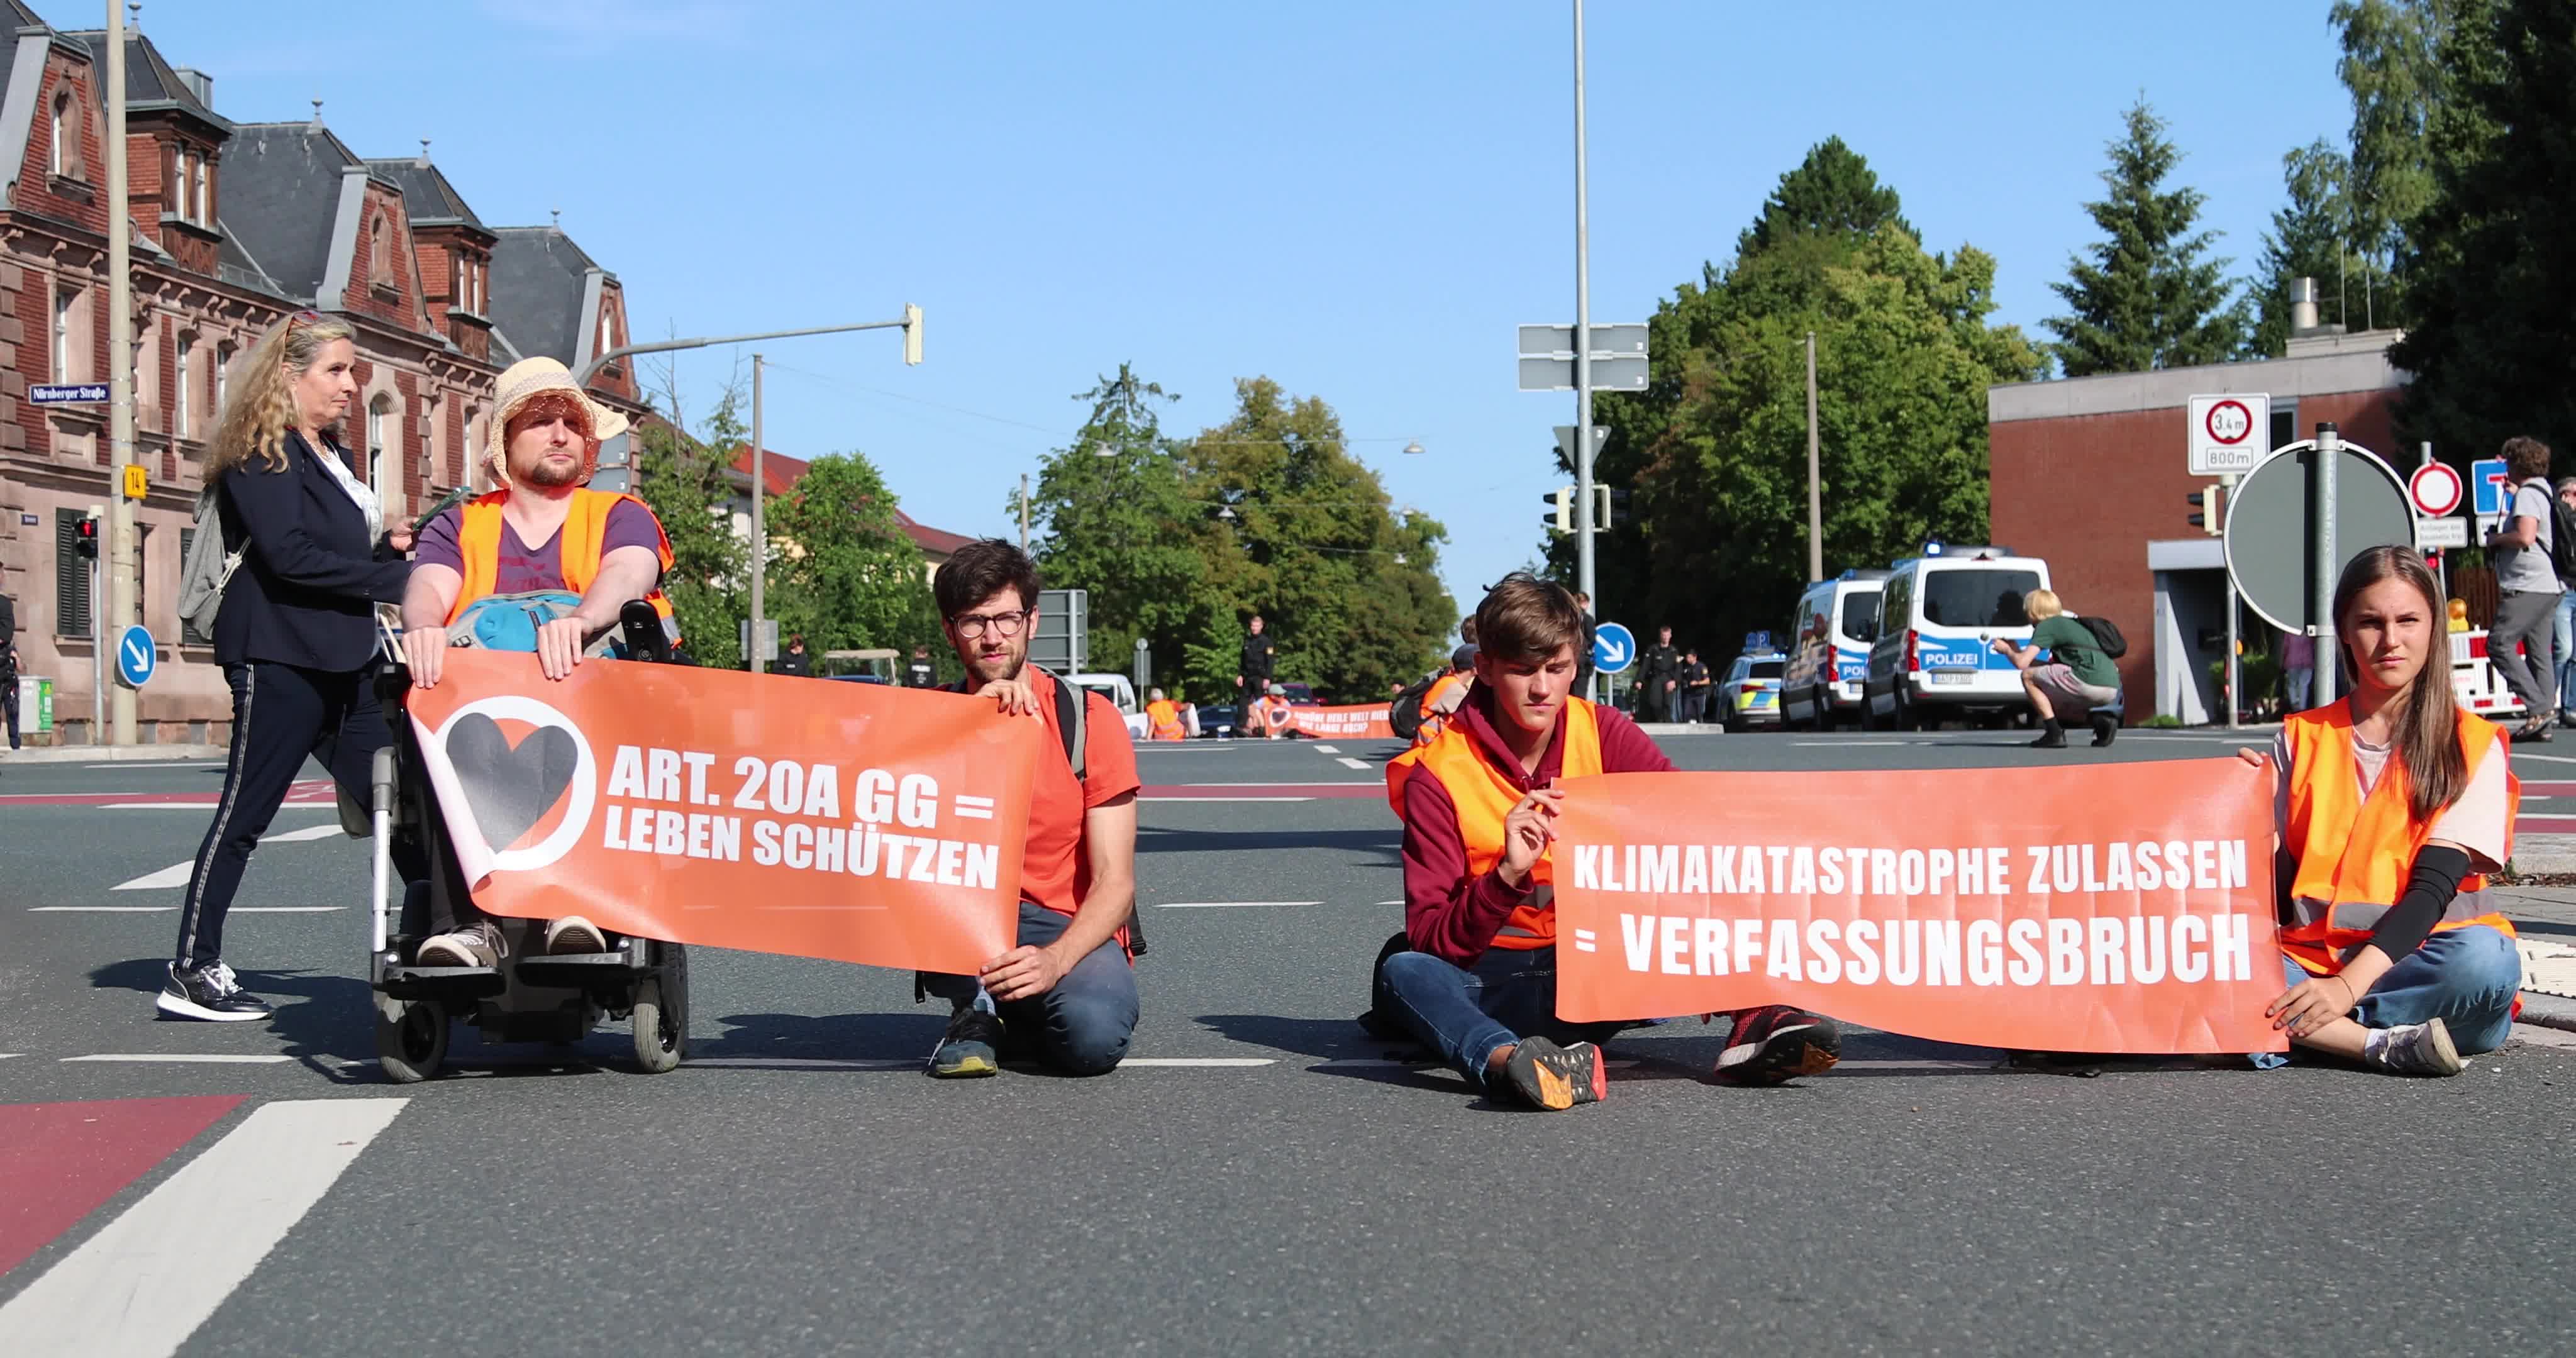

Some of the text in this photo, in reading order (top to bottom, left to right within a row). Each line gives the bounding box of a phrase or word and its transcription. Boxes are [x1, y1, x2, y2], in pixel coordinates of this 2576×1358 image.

[33, 387, 106, 400] Nürnberger Straße
[131, 472, 140, 490] 14
[1926, 653, 1978, 665] POLIZEI
[606, 744, 994, 829] ART. 20A GG =
[603, 805, 999, 890] LEBEN SCHÜTZEN
[1574, 839, 2248, 896] KLIMAKATASTROPHE ZULASSEN
[1575, 914, 2251, 986] = VERFASSUNGSBRUCH
